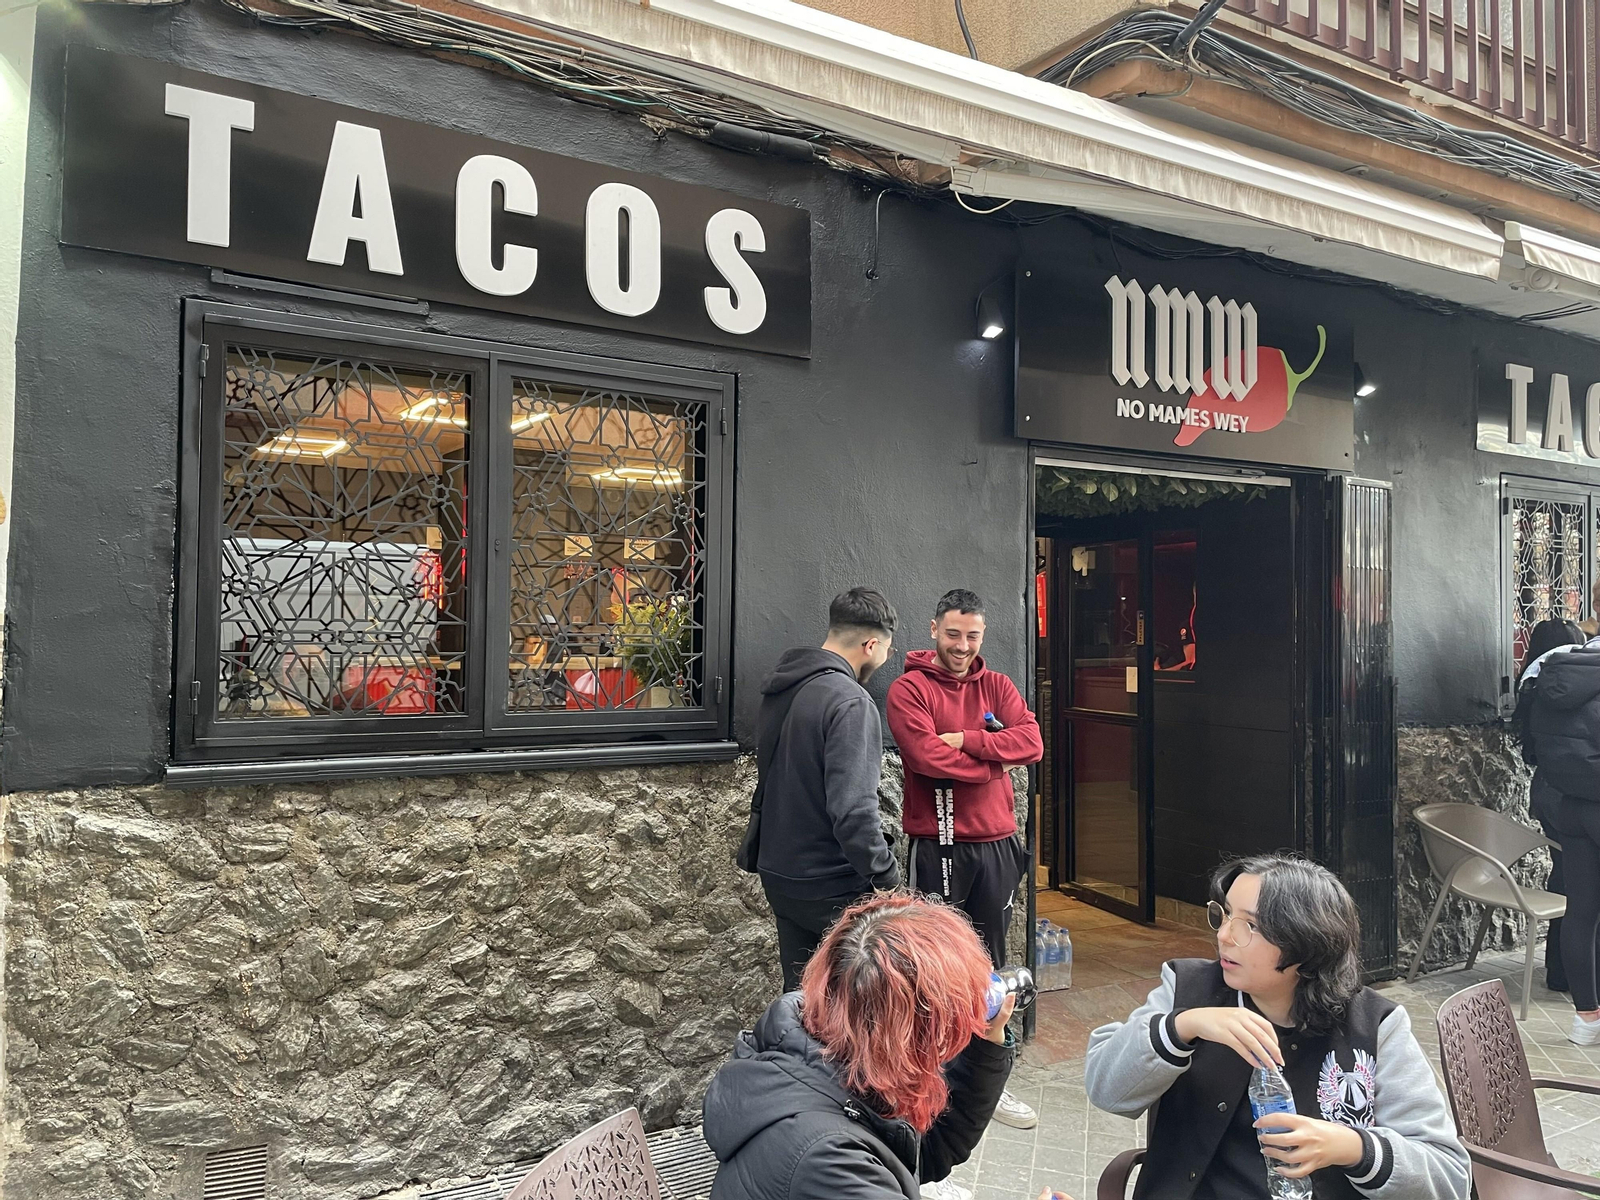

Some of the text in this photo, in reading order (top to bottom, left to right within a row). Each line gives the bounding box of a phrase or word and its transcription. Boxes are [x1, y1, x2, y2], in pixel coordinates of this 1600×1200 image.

[164, 82, 767, 334] TACOS
[1116, 397, 1250, 433] NO MAMES WEY
